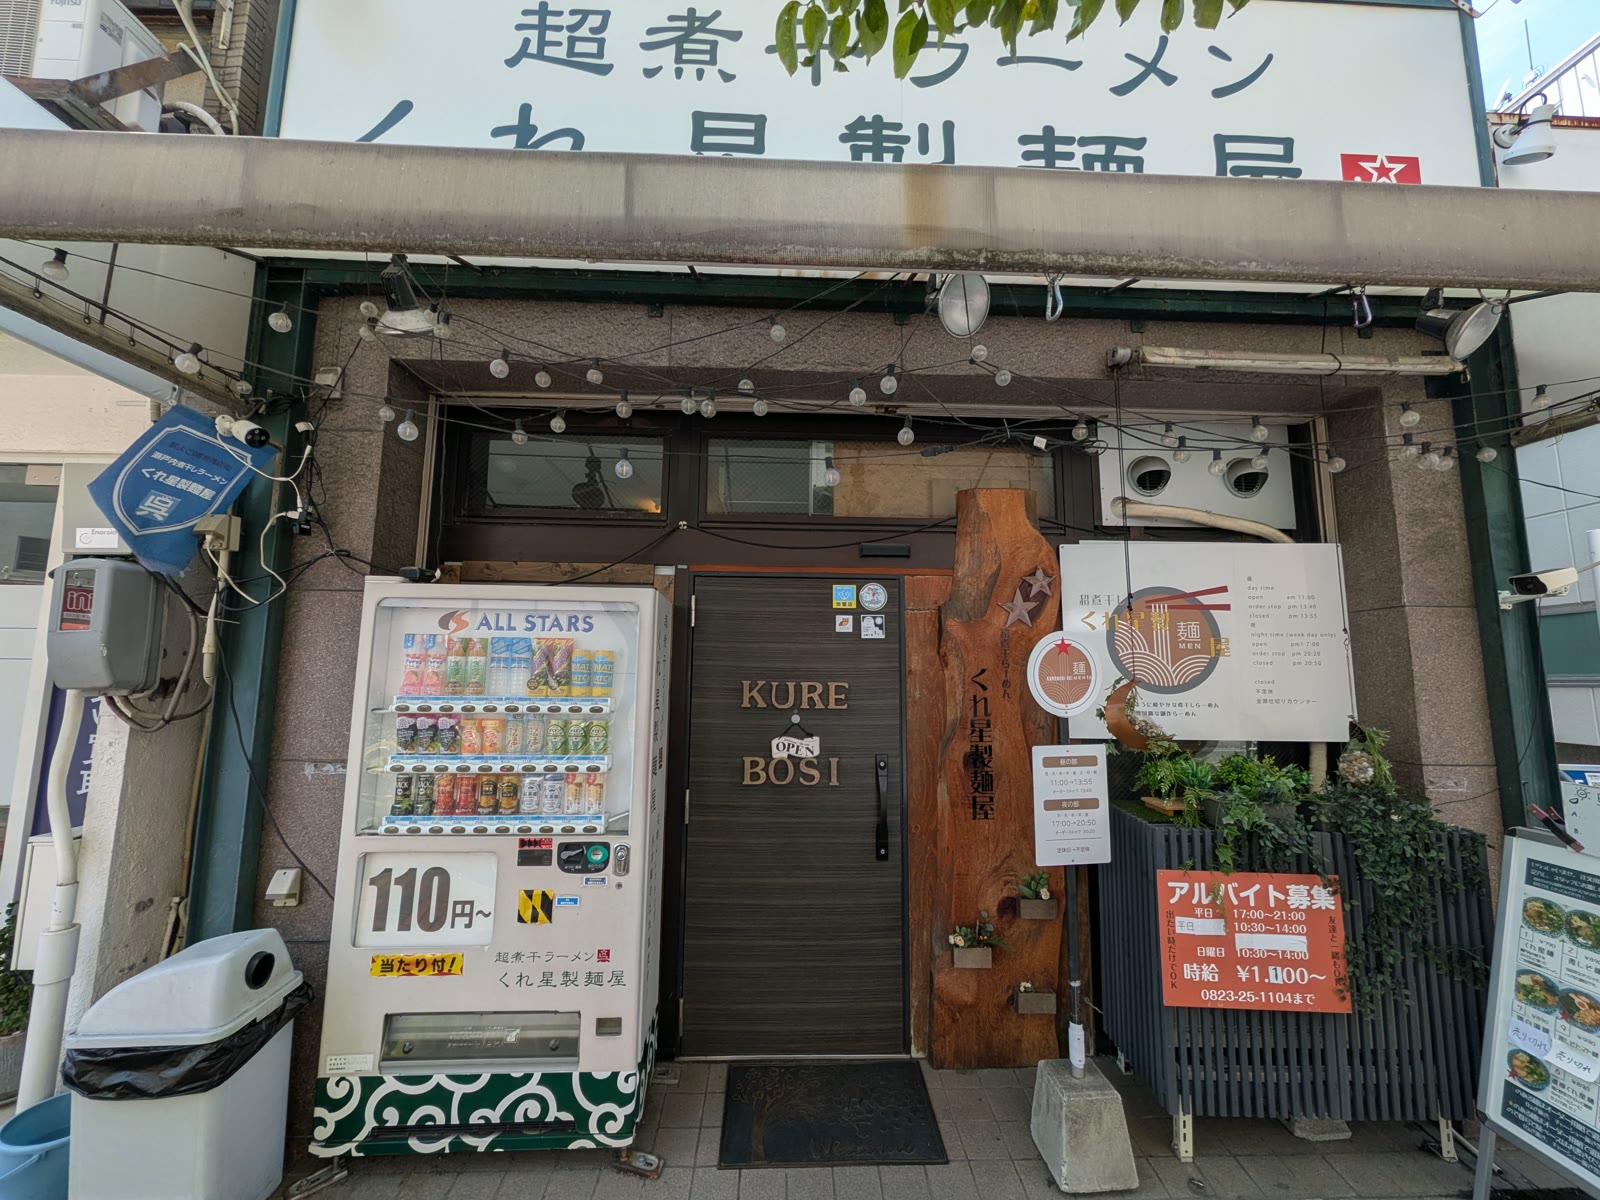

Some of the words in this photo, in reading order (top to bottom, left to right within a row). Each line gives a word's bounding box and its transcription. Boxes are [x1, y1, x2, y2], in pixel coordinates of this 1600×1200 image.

[141, 467, 217, 501] くれ星製麺屋
[475, 612, 516, 631] ALL
[524, 614, 595, 633] STARS
[740, 680, 849, 710] KURE
[776, 742, 814, 756] OPEN
[970, 669, 995, 820] くれ星製麺屋
[742, 756, 839, 785] BOSI
[1168, 882, 1336, 910] アルバイト募集
[1194, 908, 1213, 918] 平日
[1176, 920, 1195, 931] 平日
[494, 952, 595, 964] 超煮干ラーメン
[1197, 947, 1225, 958] 日曜日
[499, 970, 627, 988] くれ星製麺屋
[1184, 964, 1219, 982] 時給
[1201, 990, 1315, 1005] 0823-25-1104まで
[1512, 1027, 1548, 1051] 売り切れ
[1556, 1051, 1591, 1074] 売り切れ
